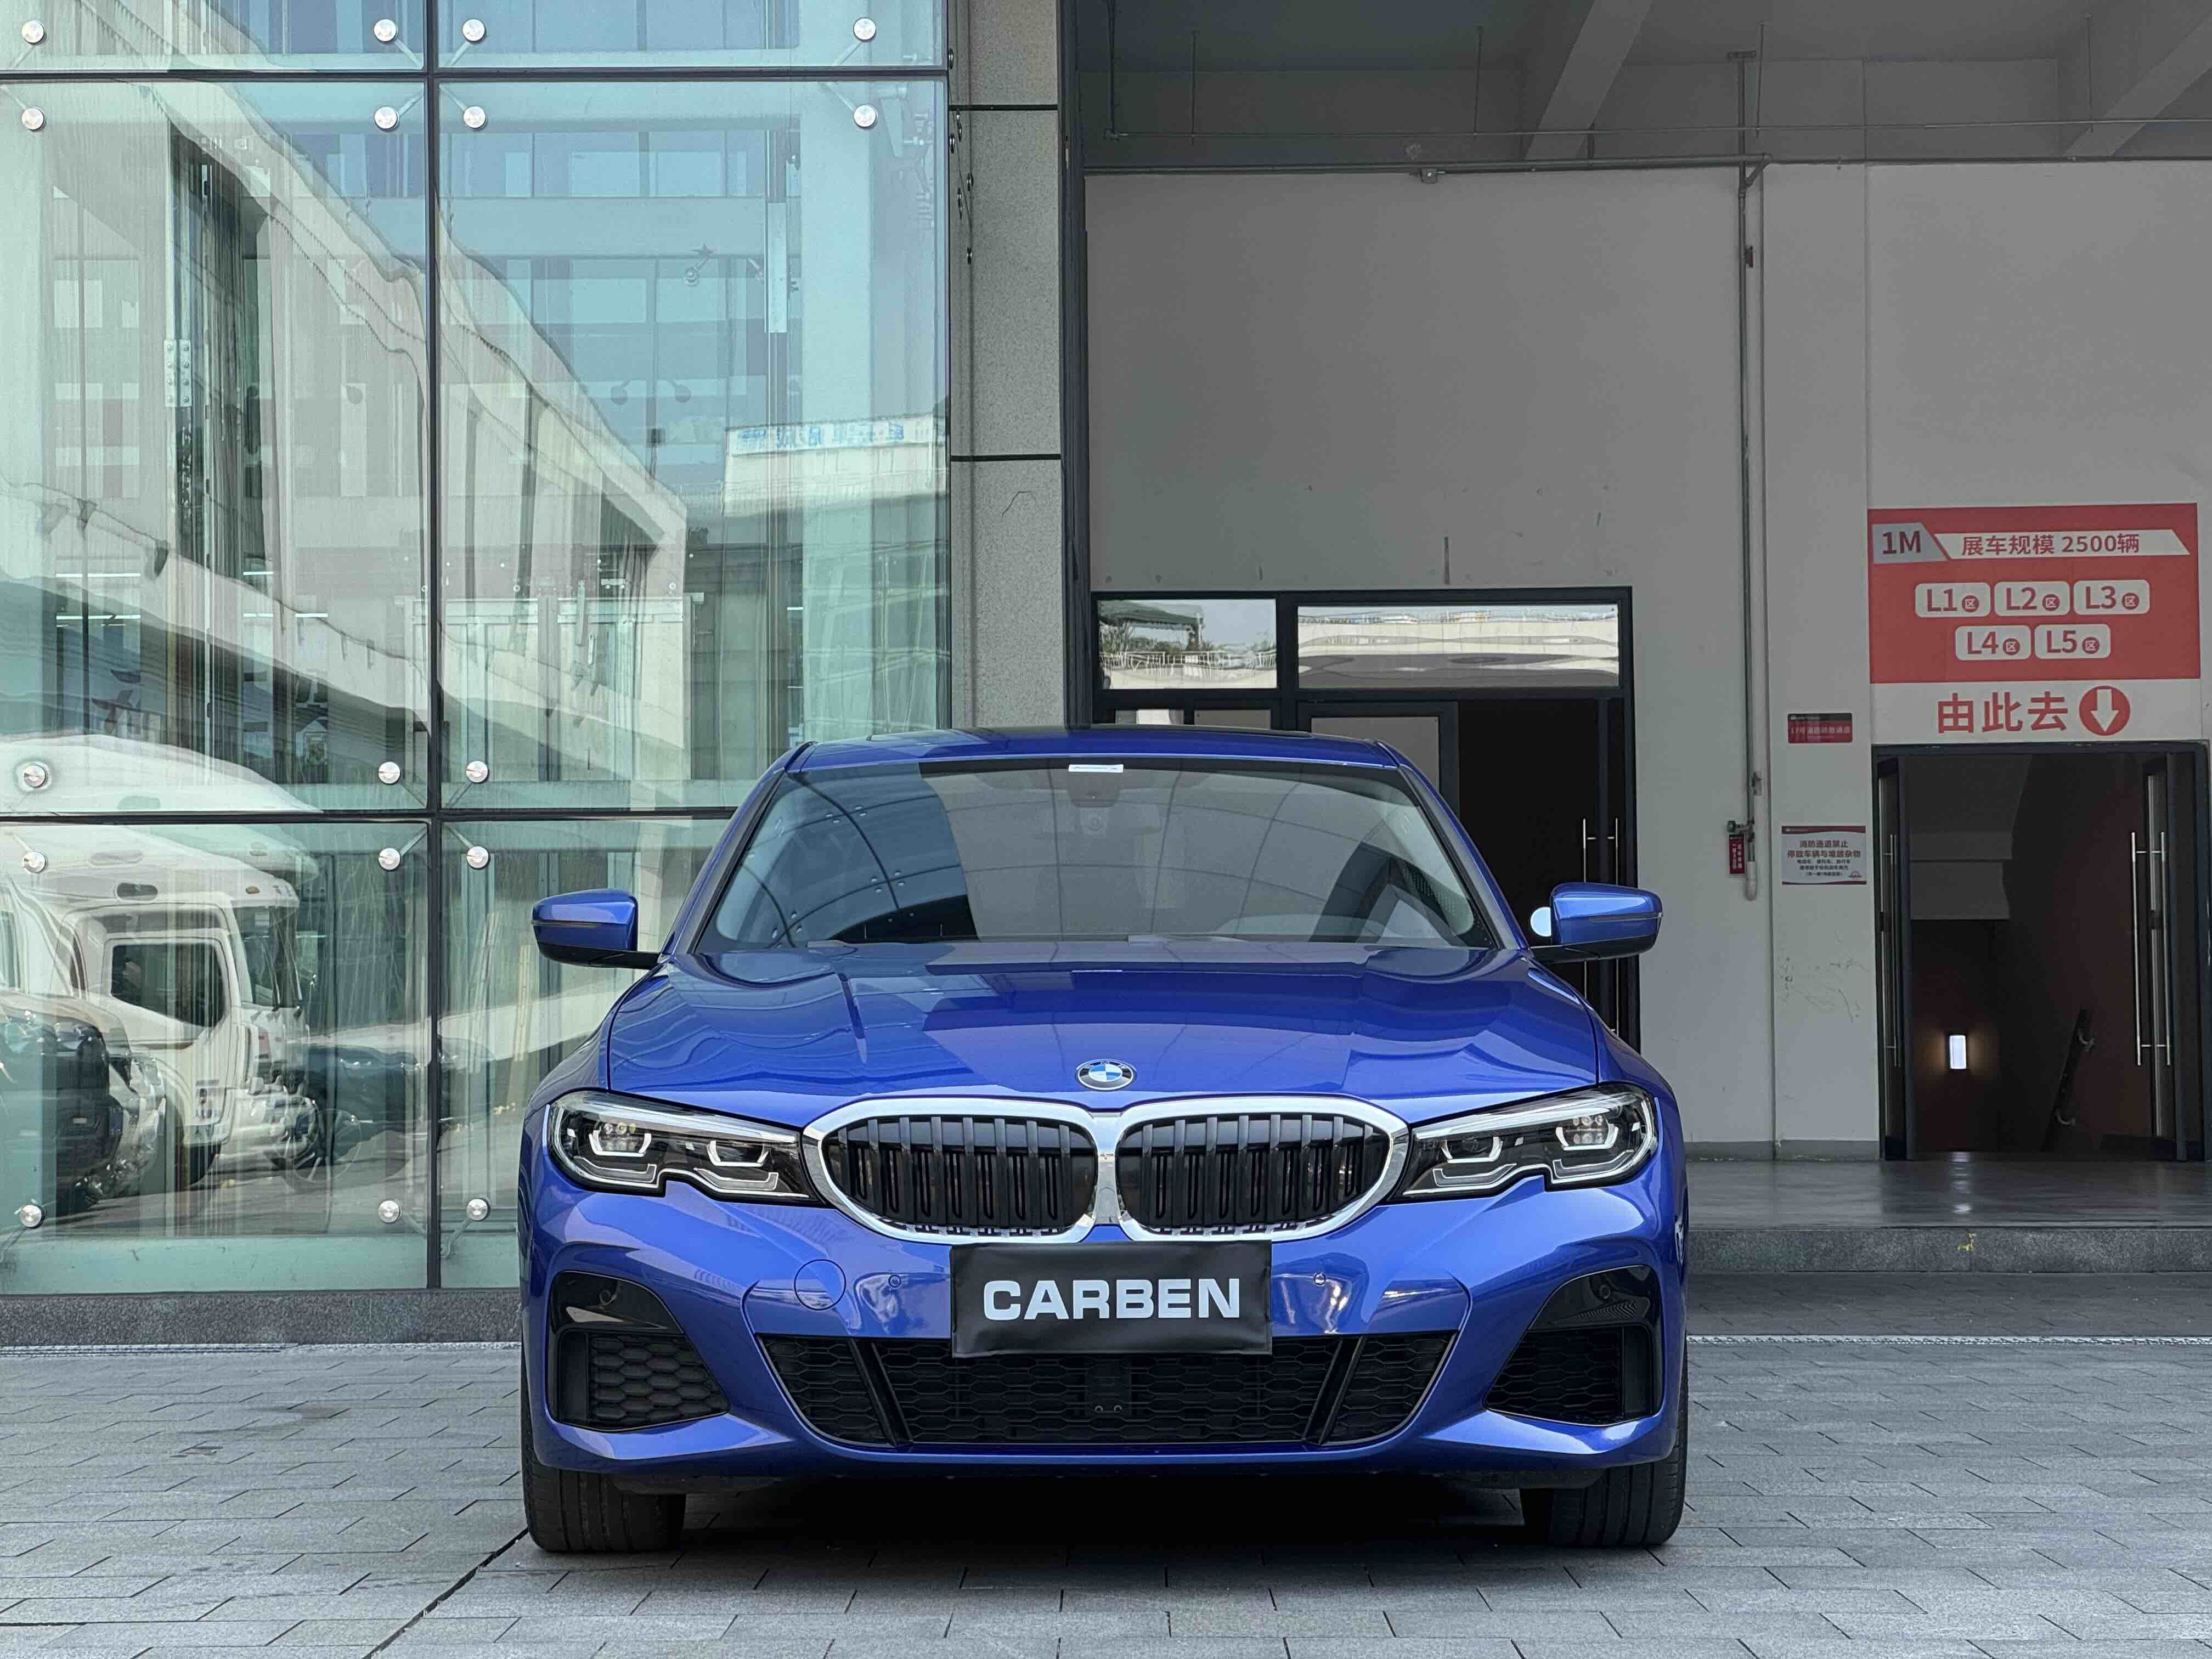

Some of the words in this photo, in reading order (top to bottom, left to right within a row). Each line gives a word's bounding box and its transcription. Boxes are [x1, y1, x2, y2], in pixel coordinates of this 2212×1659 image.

[1883, 531, 1921, 554] 1M
[1962, 535, 2055, 556] 展车规模
[2062, 534, 2140, 554] 2500辆
[1937, 691, 2069, 733] 由此去
[983, 1278, 1240, 1321] CARBEN
